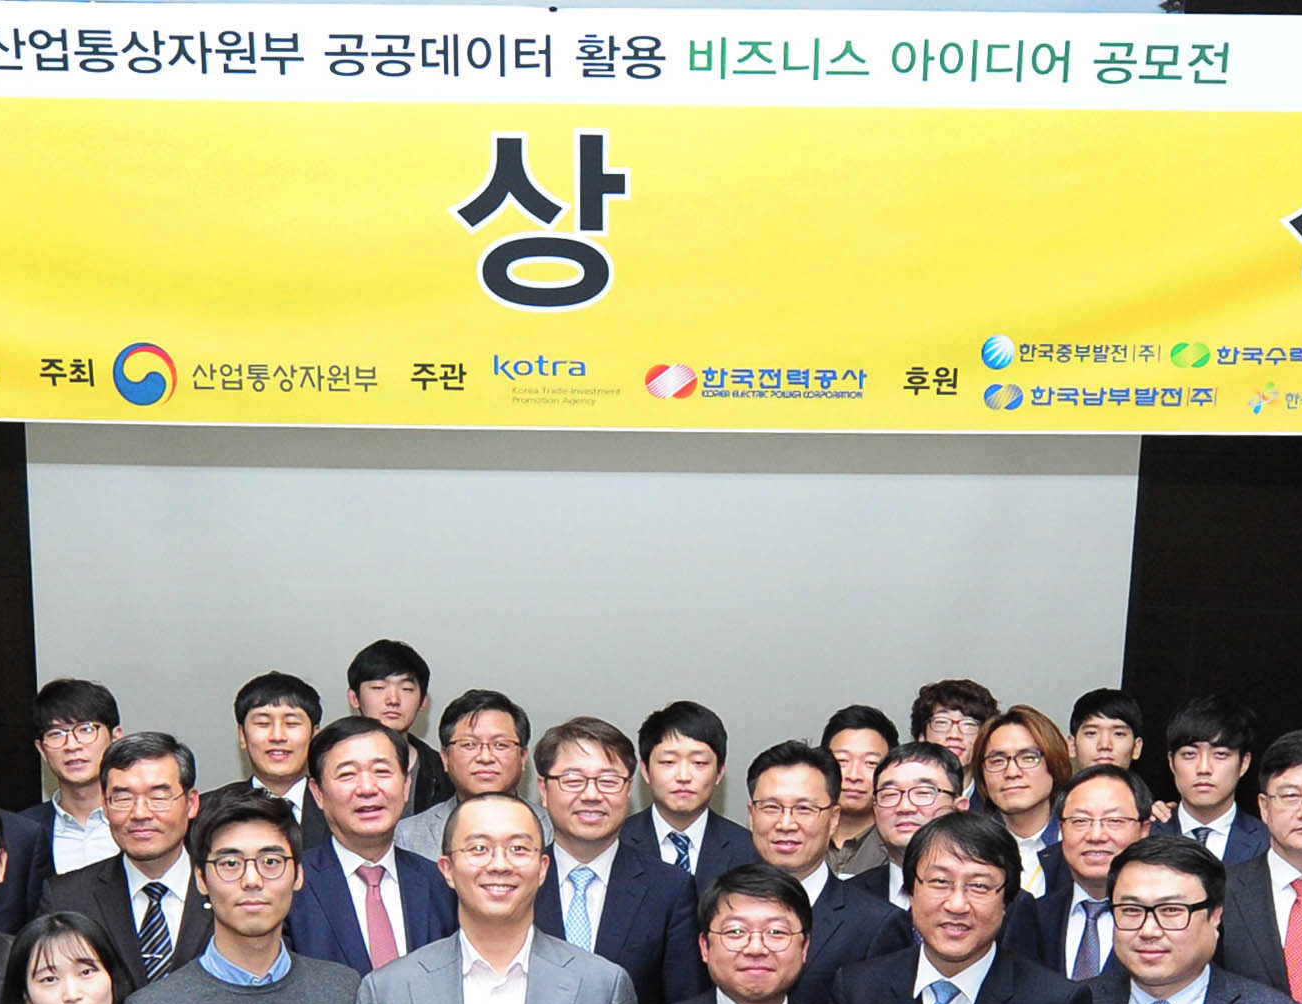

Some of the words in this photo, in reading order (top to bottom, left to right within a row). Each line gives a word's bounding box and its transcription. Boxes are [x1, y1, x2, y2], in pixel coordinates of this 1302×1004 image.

[324, 34, 552, 77] 공공데이터
[575, 34, 666, 80] 활용
[688, 36, 870, 81] 비즈니스
[891, 38, 1071, 83] 아이디어
[1094, 41, 1230, 84] 공모전
[454, 127, 629, 311] 상
[40, 358, 94, 387] 주최
[192, 363, 377, 392] 산업통상자원부
[411, 363, 466, 391] 주관
[493, 354, 586, 380] kotra
[702, 366, 867, 389] 한국전력공사
[903, 366, 958, 396] 후원
[512, 387, 539, 395] Korea
